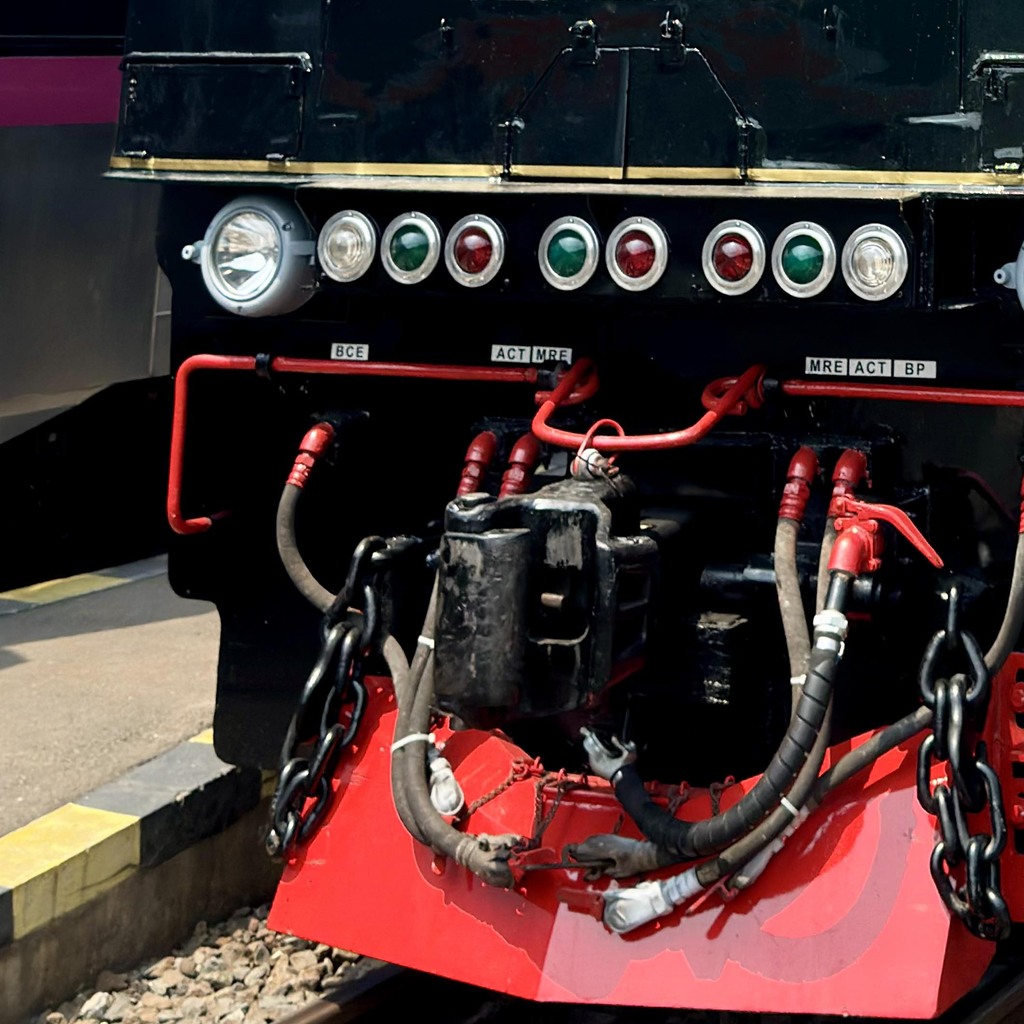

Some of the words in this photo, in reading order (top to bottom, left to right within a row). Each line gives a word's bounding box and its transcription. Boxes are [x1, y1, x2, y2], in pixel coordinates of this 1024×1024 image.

[335, 344, 364, 358] BCE
[496, 347, 526, 361] ACT
[536, 348, 567, 361] MRE
[809, 359, 843, 373] MRE
[855, 361, 887, 375] ACT
[905, 362, 926, 376] BP
